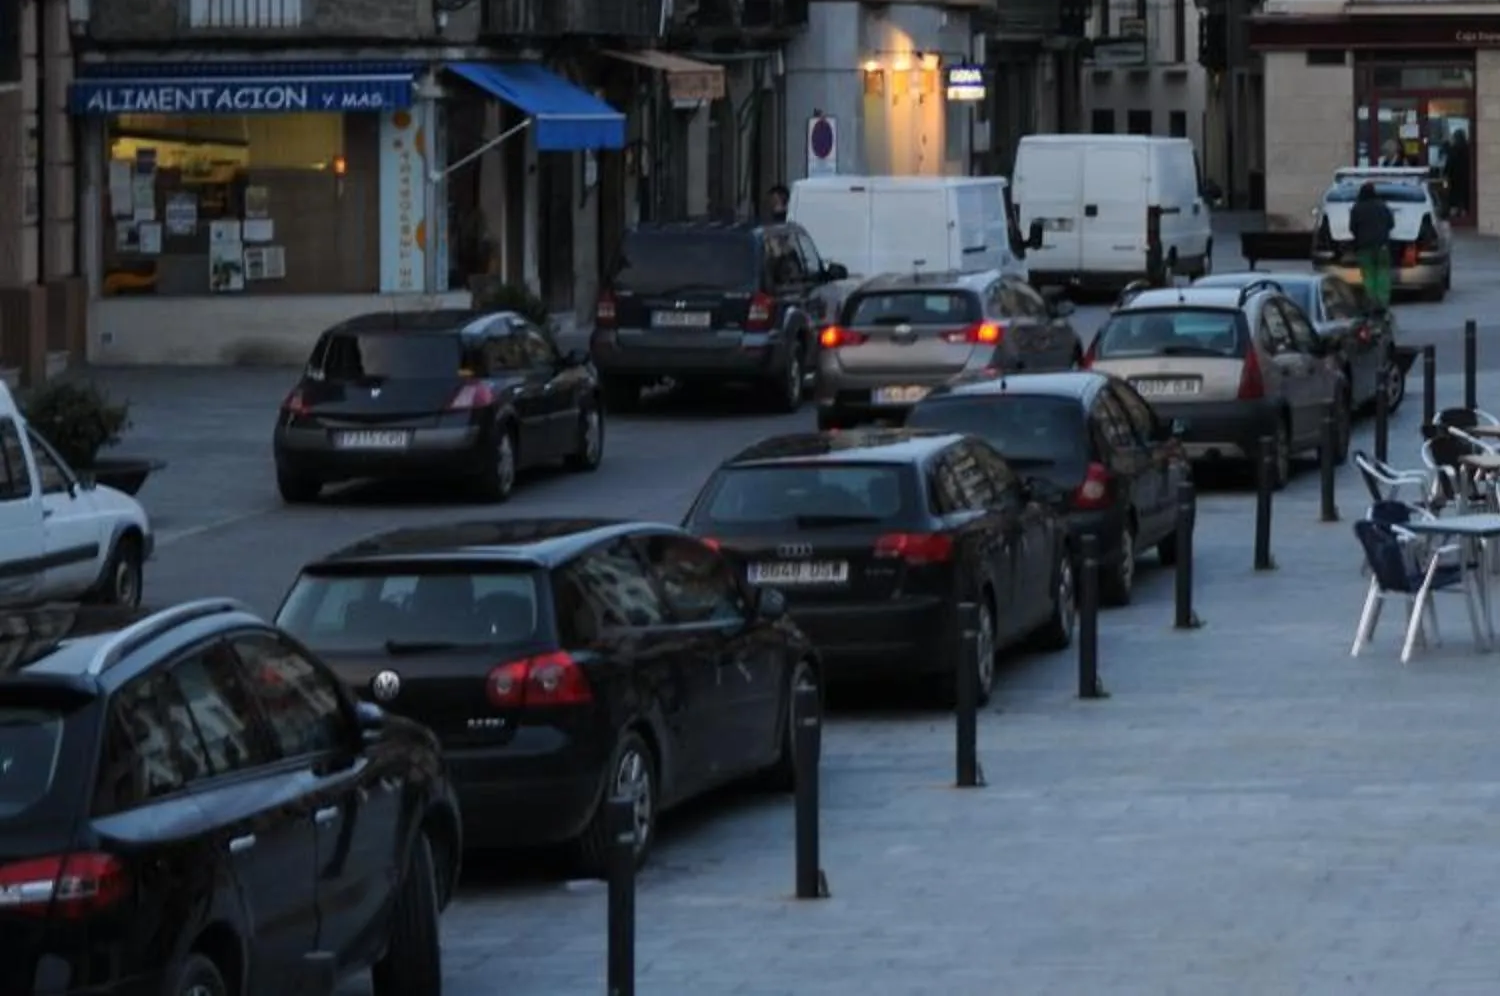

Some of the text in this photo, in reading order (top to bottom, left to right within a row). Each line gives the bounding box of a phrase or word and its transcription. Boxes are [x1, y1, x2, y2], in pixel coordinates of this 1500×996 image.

[1455, 30, 1477, 43] Caja
[87, 86, 308, 111] ALIMENTACION
[321, 92, 335, 109] Y
